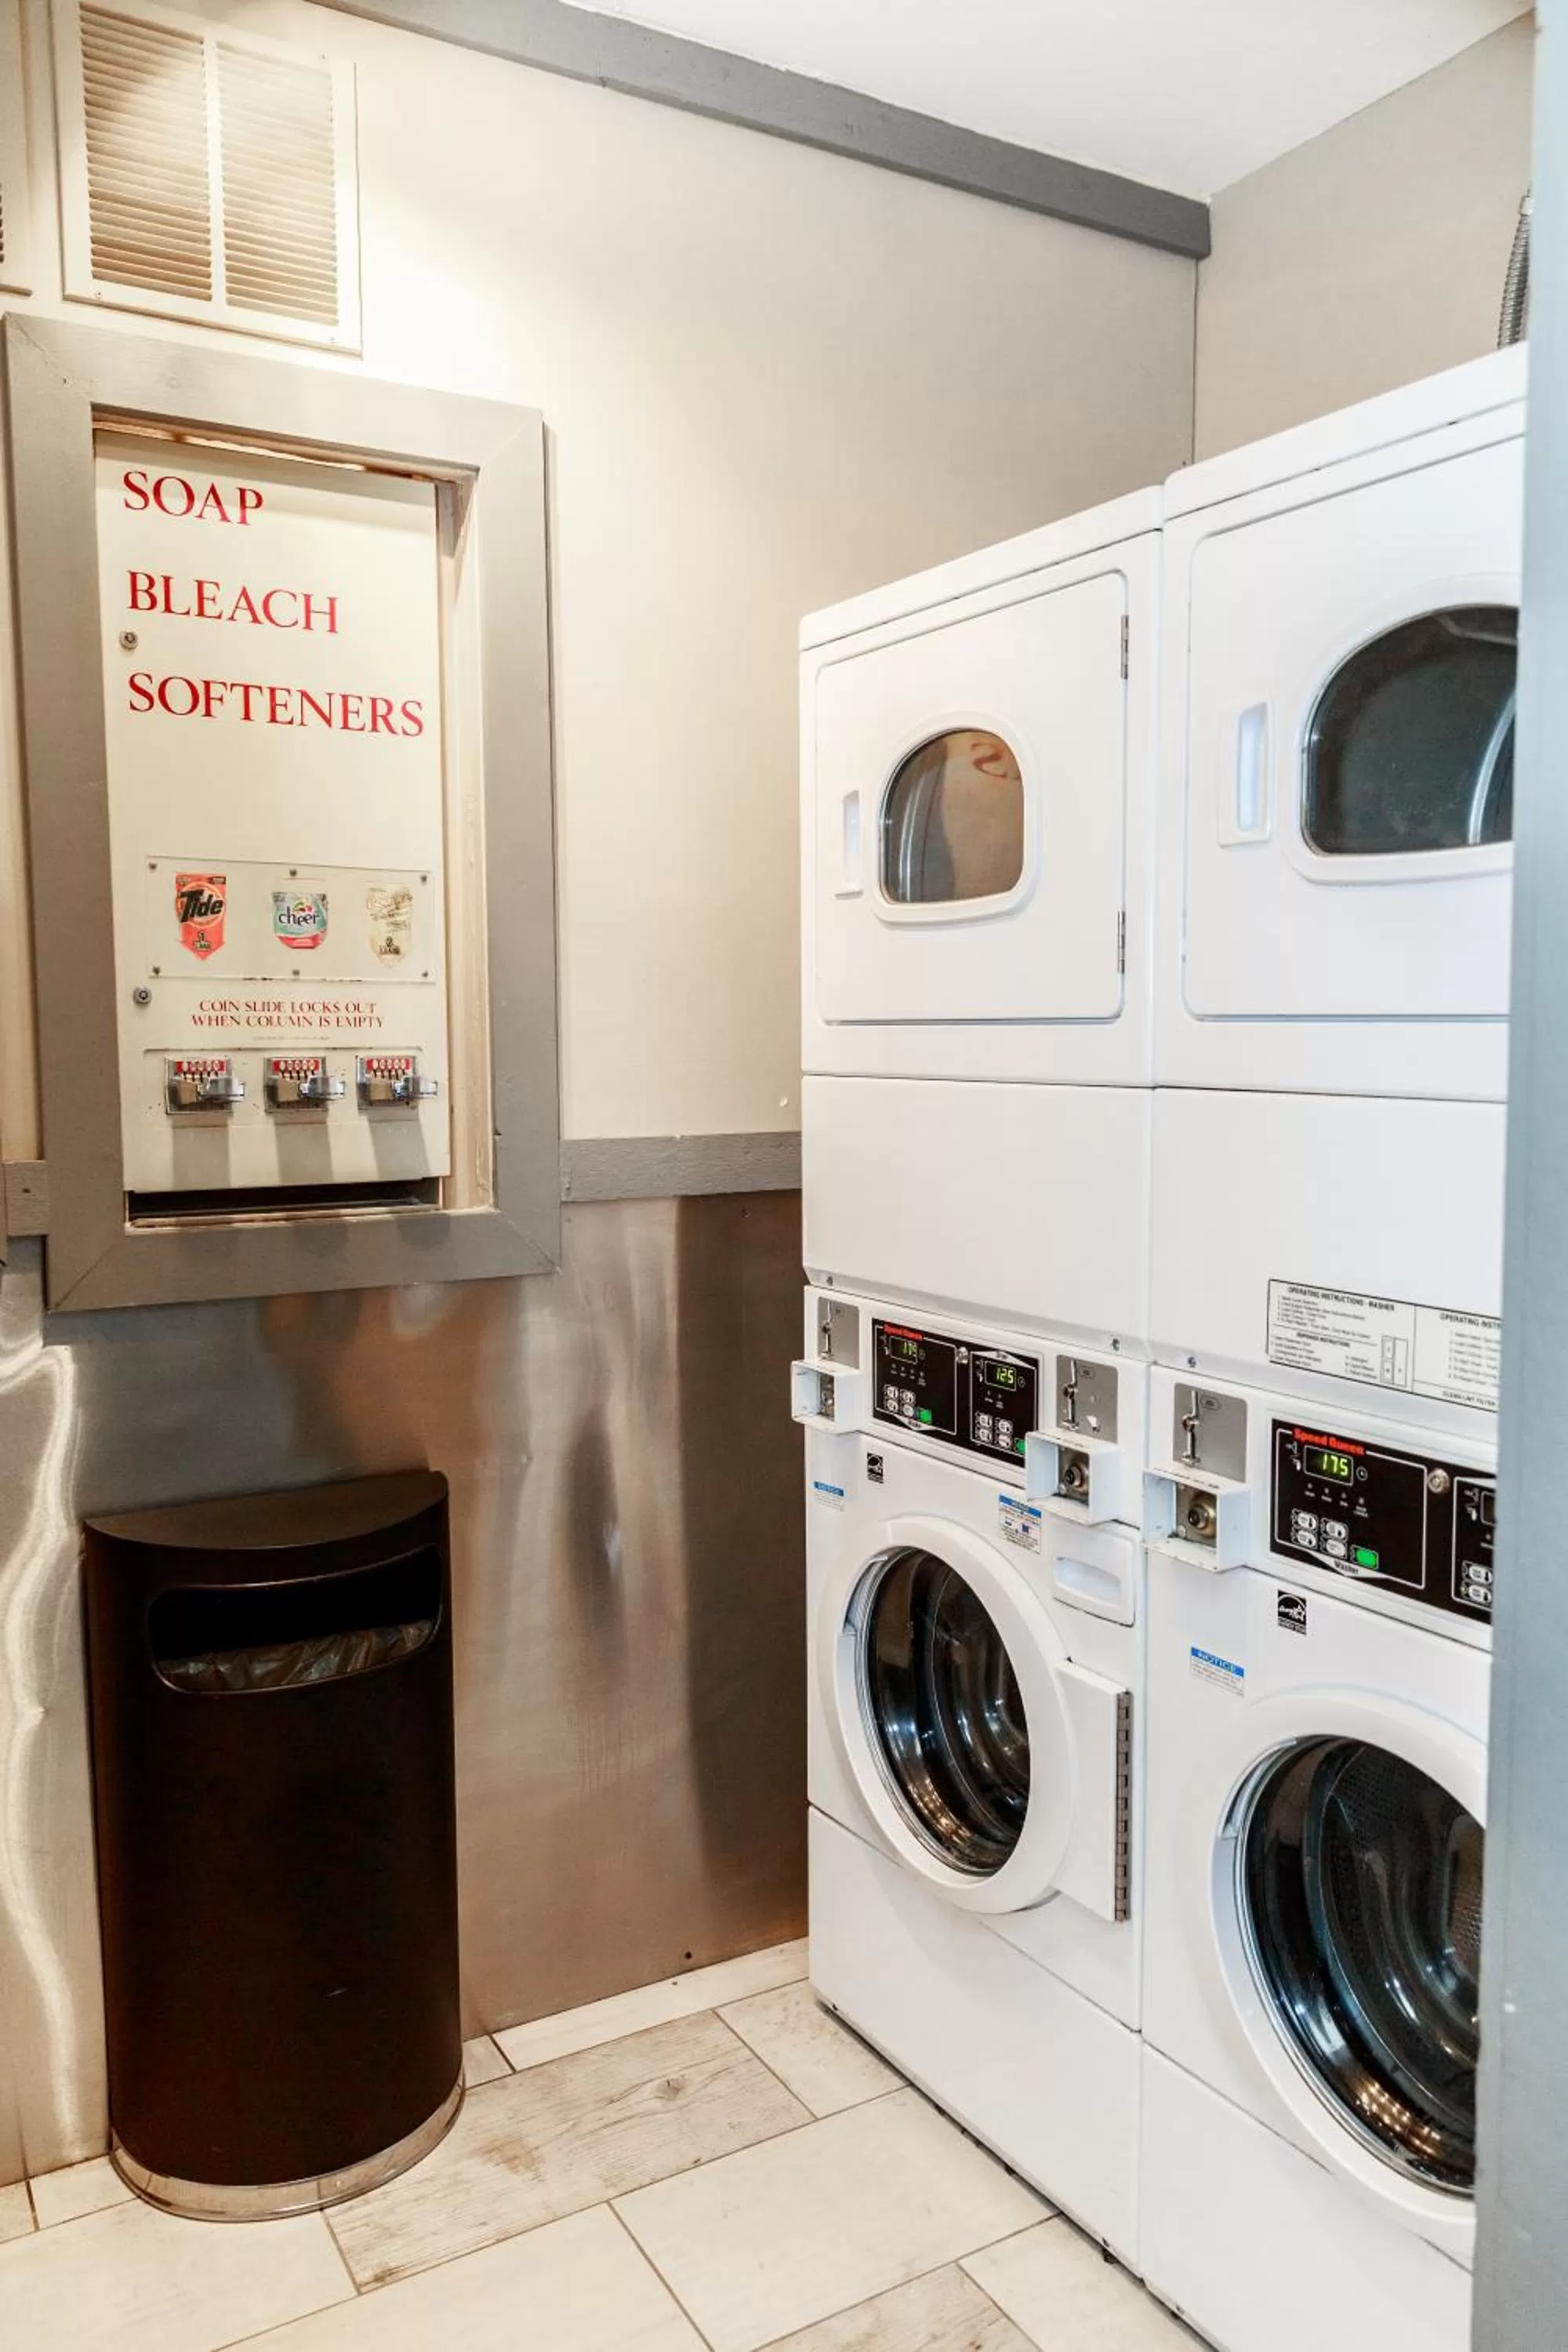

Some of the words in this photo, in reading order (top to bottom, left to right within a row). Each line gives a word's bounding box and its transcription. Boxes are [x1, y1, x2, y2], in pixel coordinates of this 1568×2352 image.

[122, 470, 263, 525] SOAP
[125, 570, 339, 633] BLEACH
[128, 672, 424, 737] SOFTENERS
[180, 889, 223, 923] Tide
[278, 906, 319, 926] cheer
[199, 1000, 239, 1012] COIN
[245, 1001, 285, 1013] SLIDE
[291, 1001, 340, 1014] LOCKS
[345, 1002, 377, 1014] OUT
[191, 1014, 241, 1027] WHEN
[245, 1014, 314, 1028] COLUMN
[318, 1016, 331, 1028] IS
[336, 1016, 386, 1029] EMPTY
[996, 1367, 1014, 1384] 125
[1294, 1428, 1327, 1446] Speed
[1323, 1452, 1348, 1476] 175
[1334, 1559, 1359, 1574] Washer
